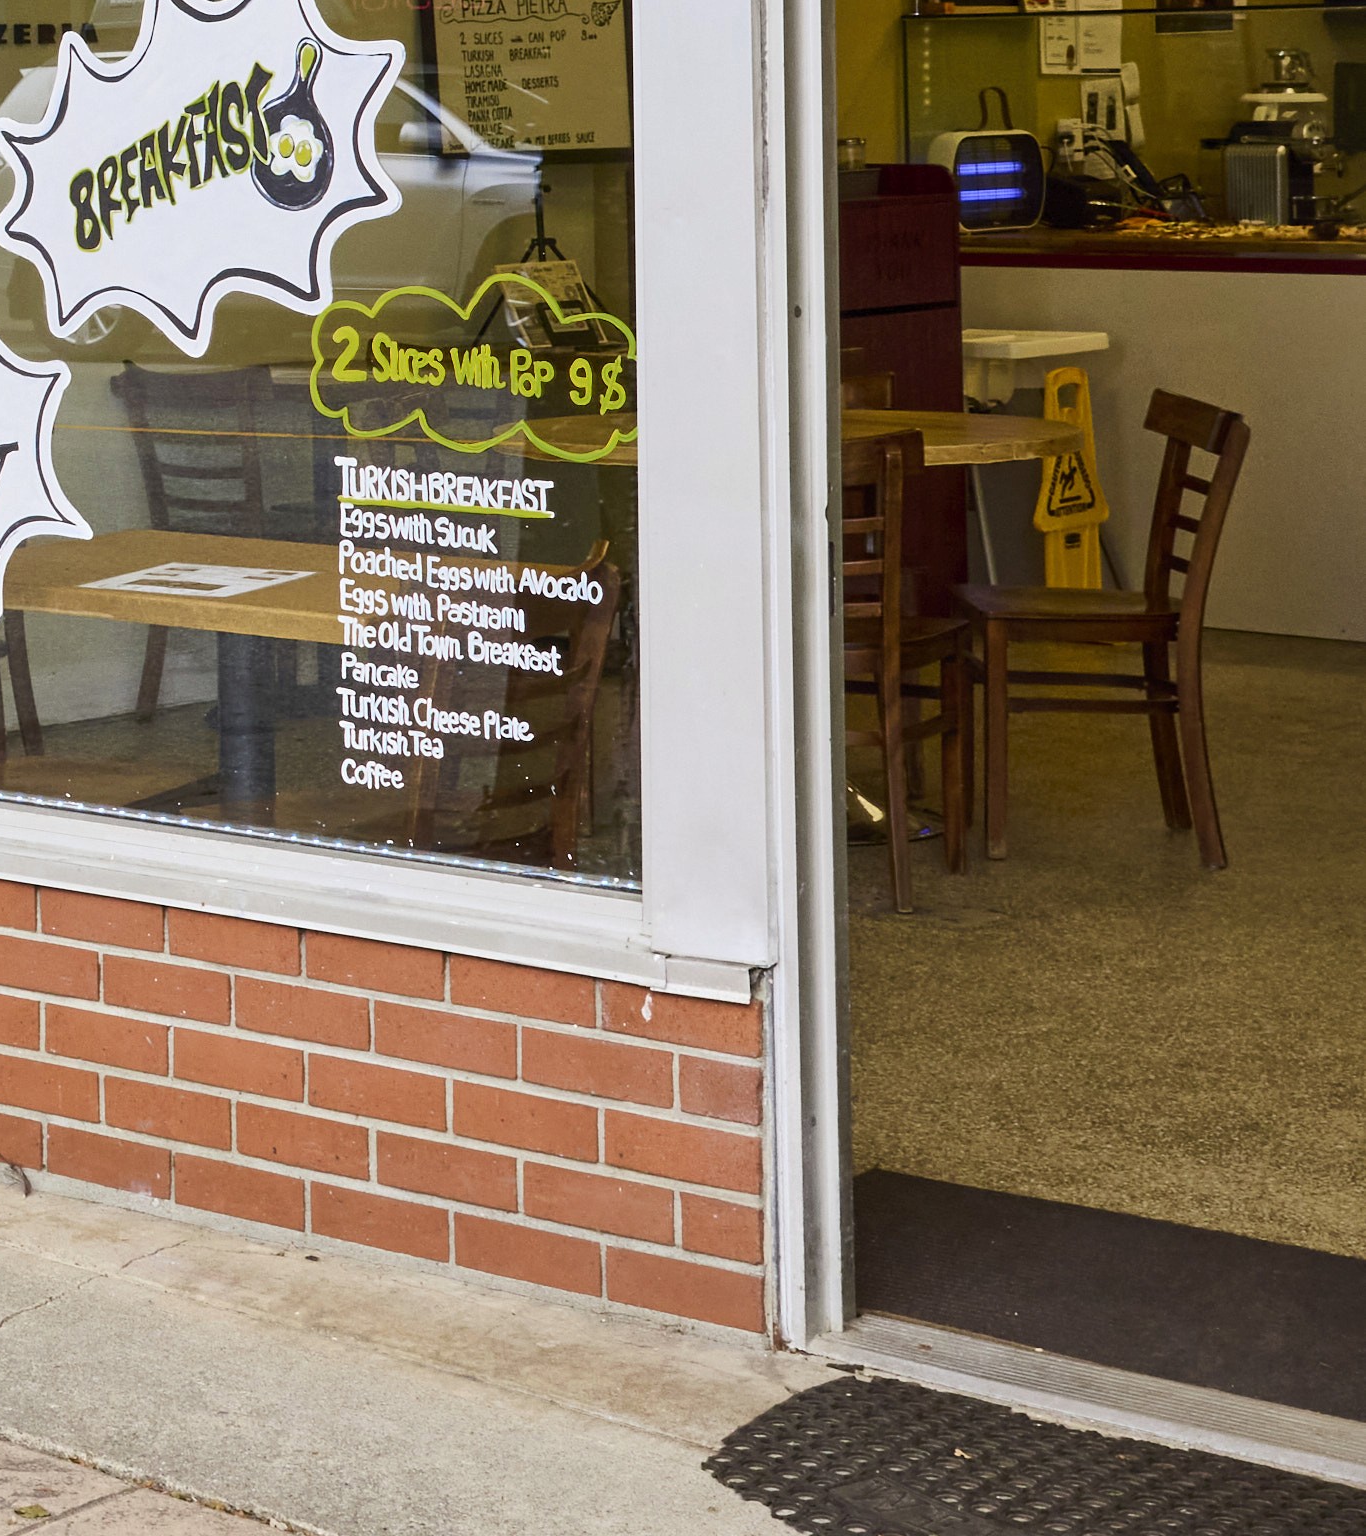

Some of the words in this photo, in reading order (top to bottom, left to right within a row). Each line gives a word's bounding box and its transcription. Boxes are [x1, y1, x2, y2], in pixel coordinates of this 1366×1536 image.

[528, 31, 545, 44] CAN
[550, 29, 567, 42] POP
[464, 65, 504, 78] LASAGNA
[521, 76, 559, 90] DESSERTS
[67, 60, 275, 252] BREAKFAST
[331, 326, 367, 383] 2
[339, 503, 389, 539] Eggs
[338, 540, 422, 582] Poached
[426, 556, 474, 592] Eggs
[473, 566, 517, 595] with
[339, 578, 390, 617] Eggs
[390, 592, 435, 623] with
[437, 594, 526, 634] Pastrami
[338, 615, 377, 649] The
[378, 621, 412, 654] Old
[413, 625, 465, 662] Town
[467, 631, 564, 677] Breakfast
[340, 652, 420, 690] Pancake
[336, 687, 413, 728] Turkish
[413, 697, 481, 737] Cheese
[483, 710, 535, 743] Plate
[339, 721, 411, 758] Turkish
[407, 730, 445, 760] Tea
[340, 758, 405, 790] Coffee
